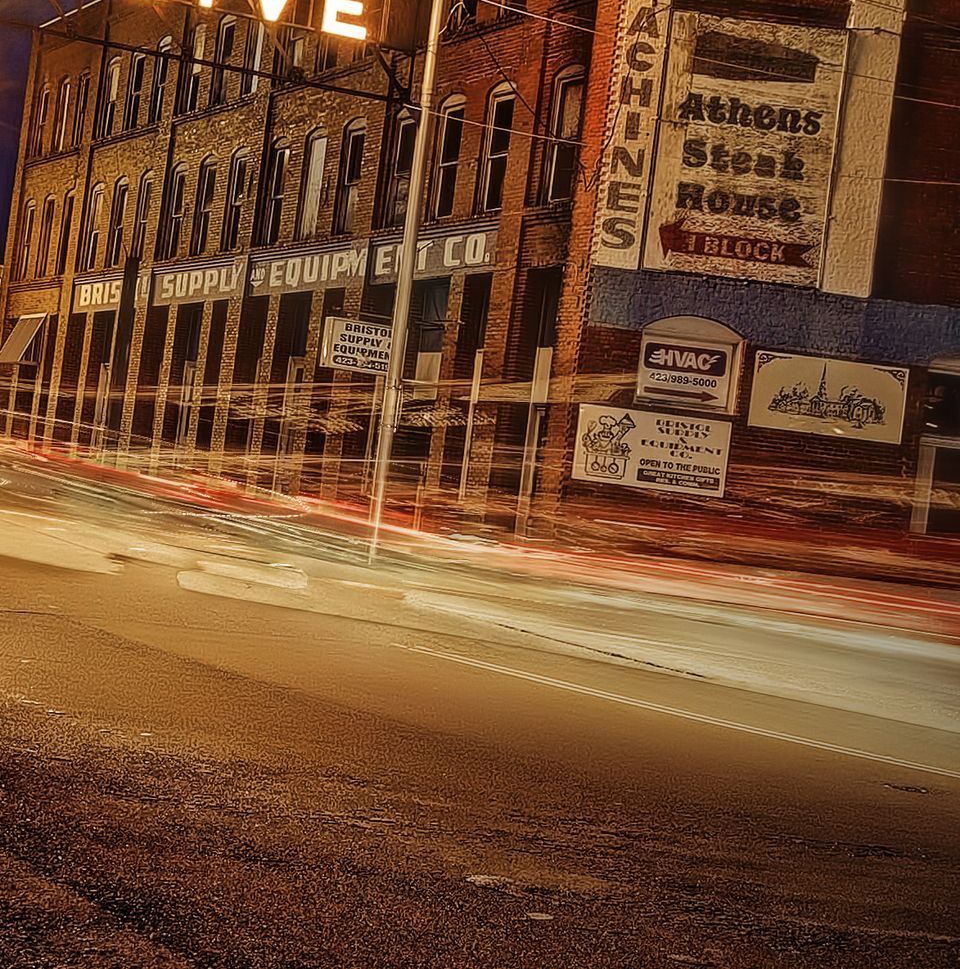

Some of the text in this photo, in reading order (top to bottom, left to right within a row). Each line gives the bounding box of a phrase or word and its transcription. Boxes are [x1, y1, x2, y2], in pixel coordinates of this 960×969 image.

[679, 92, 825, 136] Athens
[682, 139, 805, 181] Steak
[675, 181, 802, 222] House
[704, 236, 785, 262] BLOCK
[79, 275, 149, 307] BRISL
[161, 263, 244, 299] SUPPLY
[250, 268, 266, 282] AND
[443, 232, 490, 267] CO.
[333, 344, 390, 360] EQUIPMEN
[340, 334, 382, 348] SUPPLY
[658, 348, 712, 371] HVAC
[649, 372, 717, 388] 423/989-5000
[639, 458, 721, 475] OPEN TO THE PUBLIC
